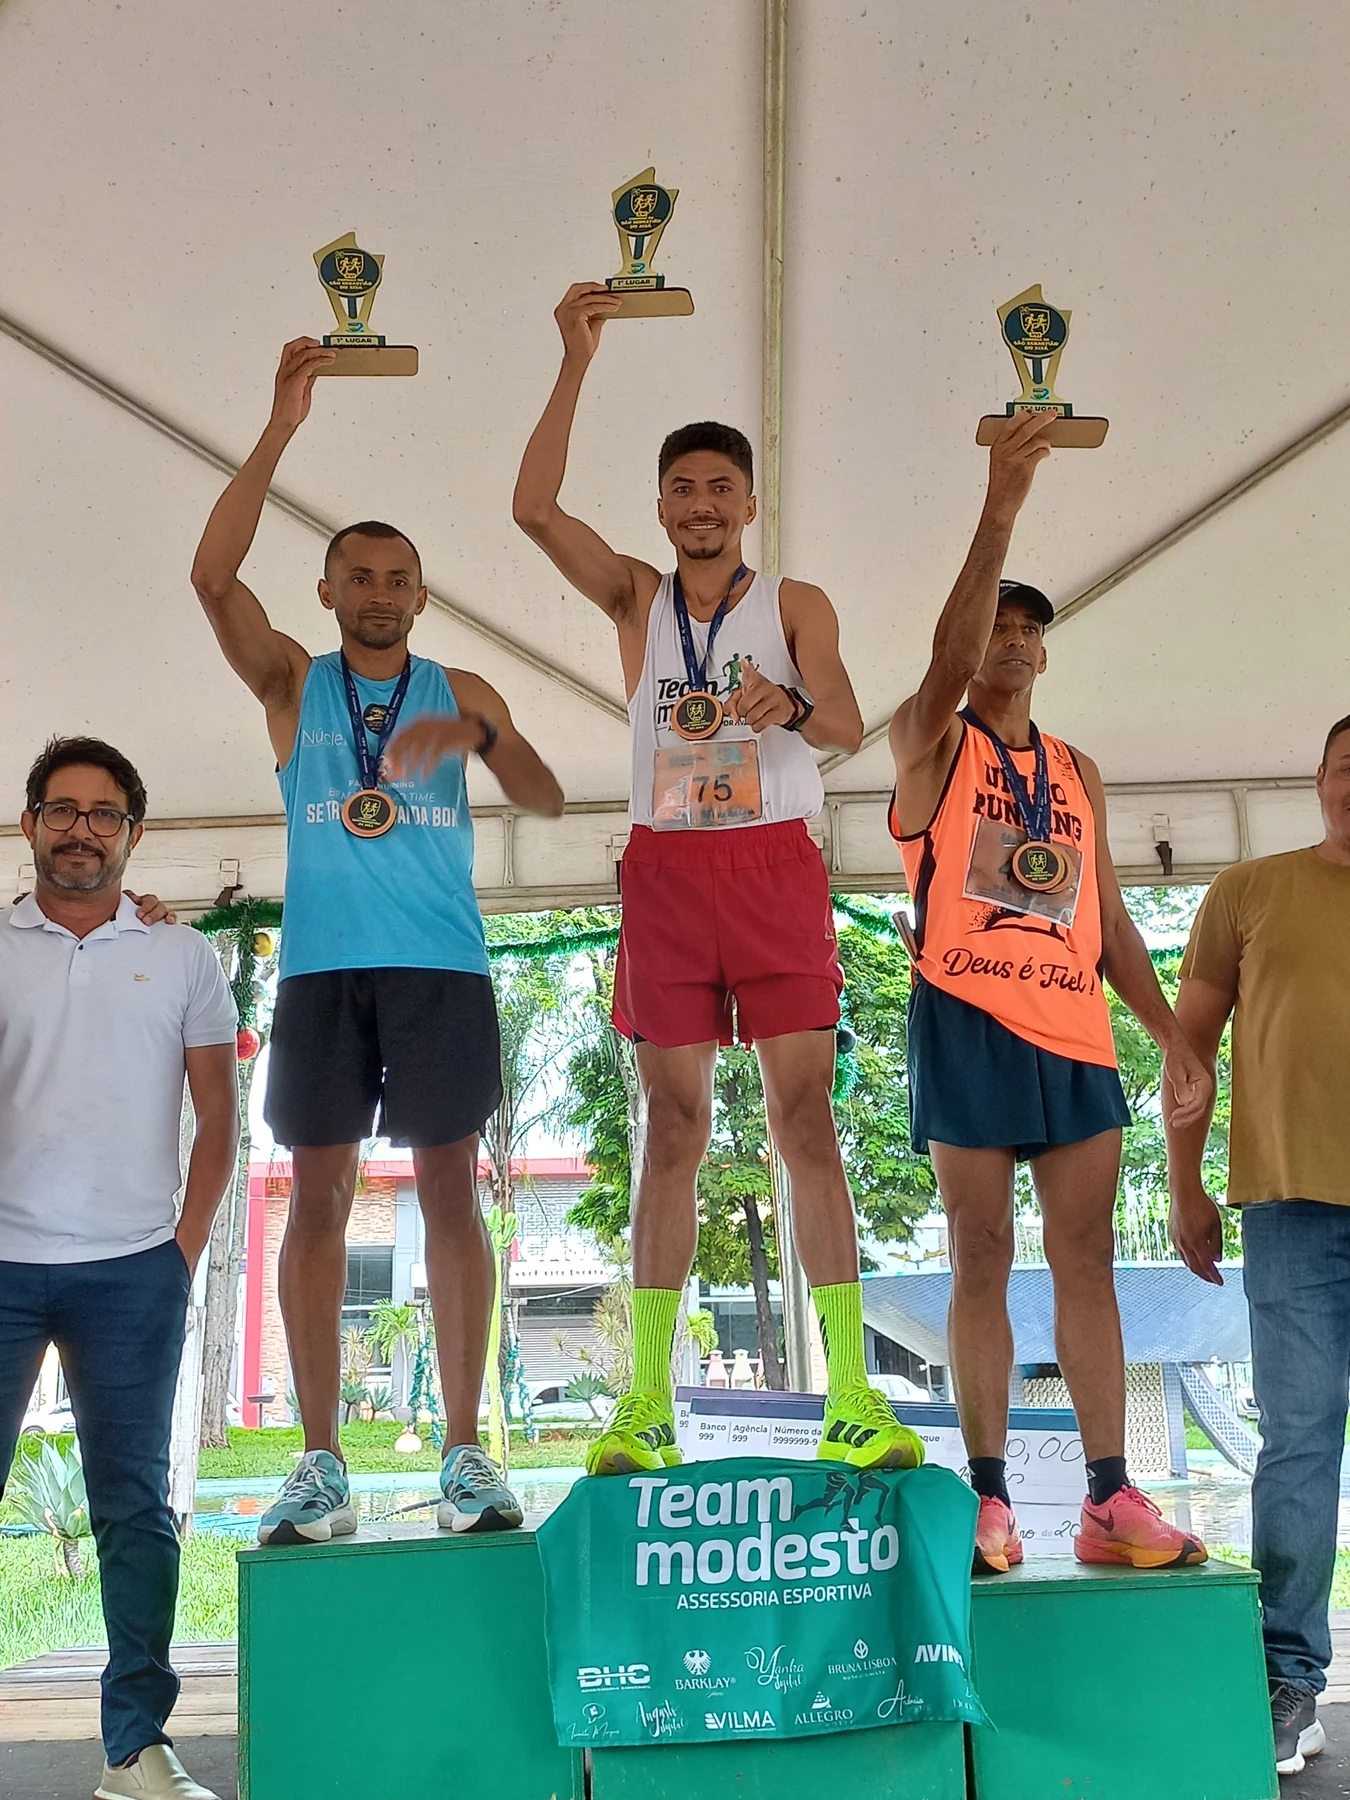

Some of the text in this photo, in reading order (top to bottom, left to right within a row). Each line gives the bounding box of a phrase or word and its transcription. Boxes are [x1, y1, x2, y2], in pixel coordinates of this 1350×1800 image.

[409, 792, 435, 802] TIME
[306, 803, 324, 823] SE
[943, 948, 1014, 978] Deus
[1019, 957, 1036, 980] é
[700, 1423, 726, 1431] Banco
[733, 1424, 768, 1434] Agência
[774, 1426, 809, 1436] Número
[773, 1437, 818, 1446] 9999999-9
[629, 1477, 793, 1529] Team
[635, 1517, 900, 1587] modesto
[677, 1582, 872, 1610] ASSESSORIA ESPORTIVA
[828, 1663, 862, 1675] BRUNA
[794, 1709, 854, 1725] ALLEGRO
